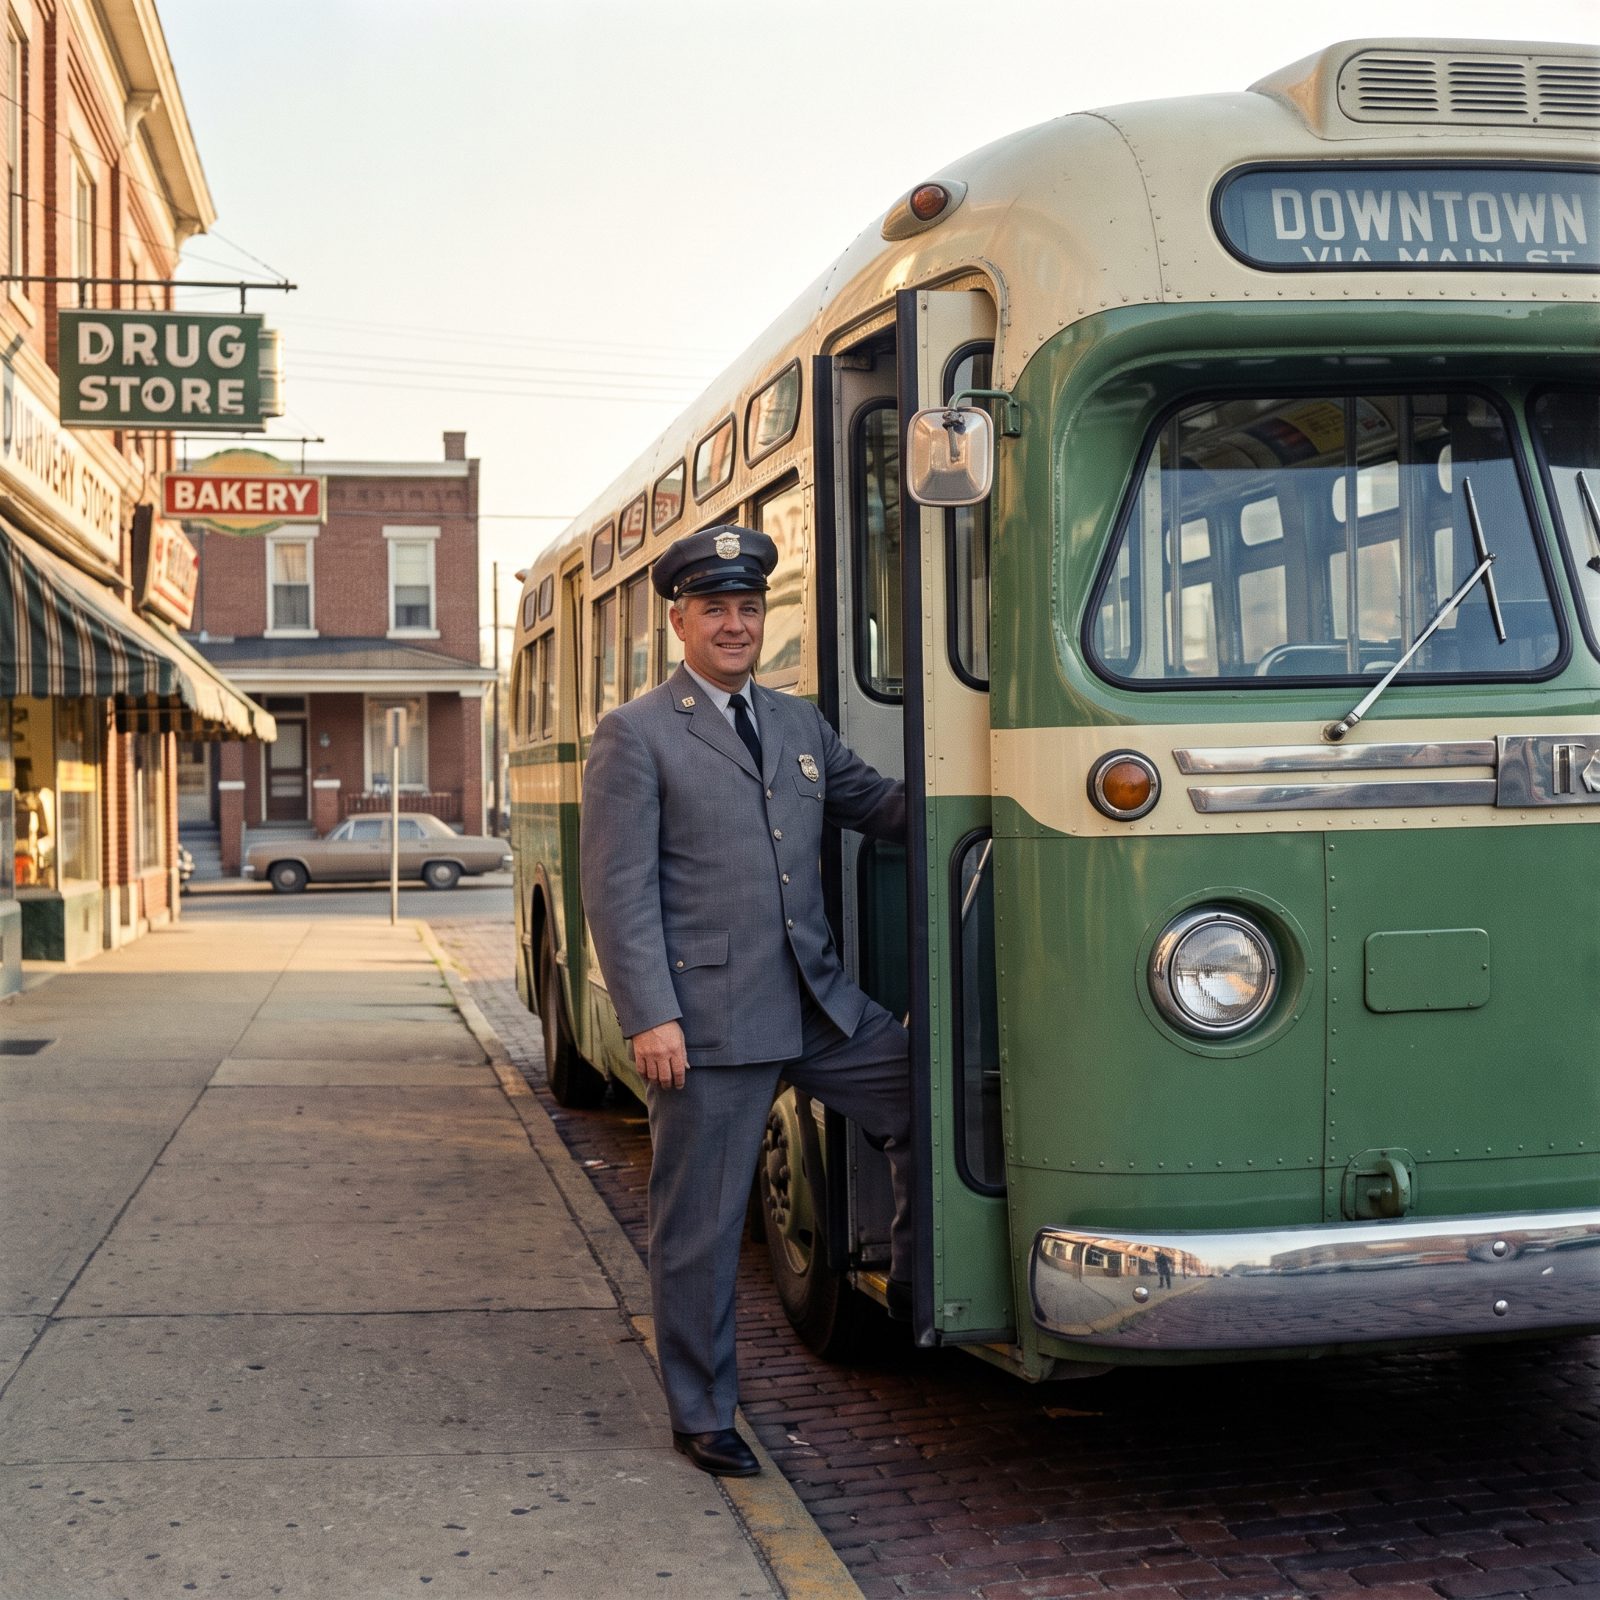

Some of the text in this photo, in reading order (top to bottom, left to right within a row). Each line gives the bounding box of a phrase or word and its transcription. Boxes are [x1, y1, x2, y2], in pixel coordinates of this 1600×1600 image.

[1271, 188, 1588, 245] DOWNTOWN
[78, 322, 246, 369] DRUG
[79, 375, 245, 414] STORE
[174, 480, 312, 512] BAKERY
